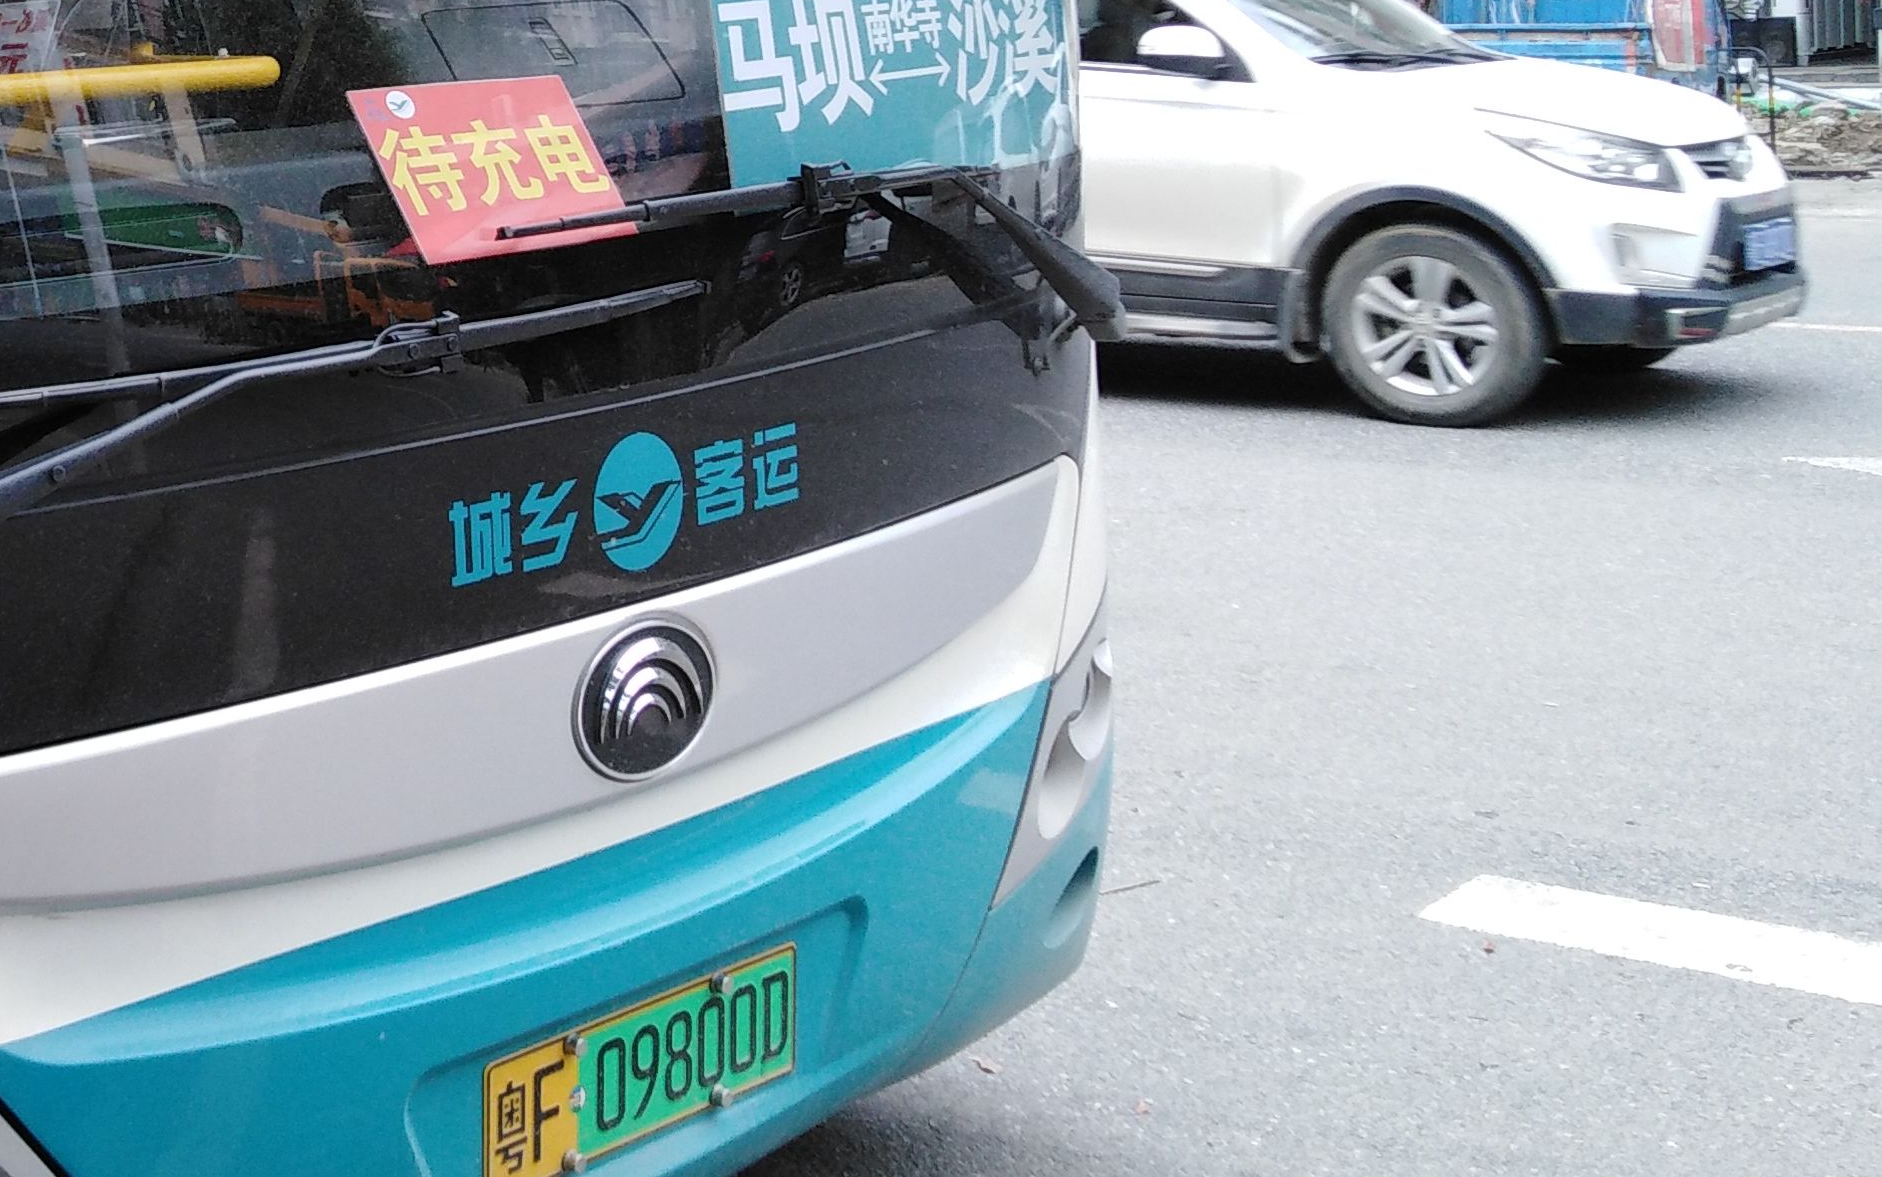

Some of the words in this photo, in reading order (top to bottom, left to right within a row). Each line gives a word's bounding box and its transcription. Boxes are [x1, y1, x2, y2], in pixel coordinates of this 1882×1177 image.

[379, 113, 610, 217] 待充电
[448, 478, 578, 587] 城乡
[693, 422, 801, 526] 客运
